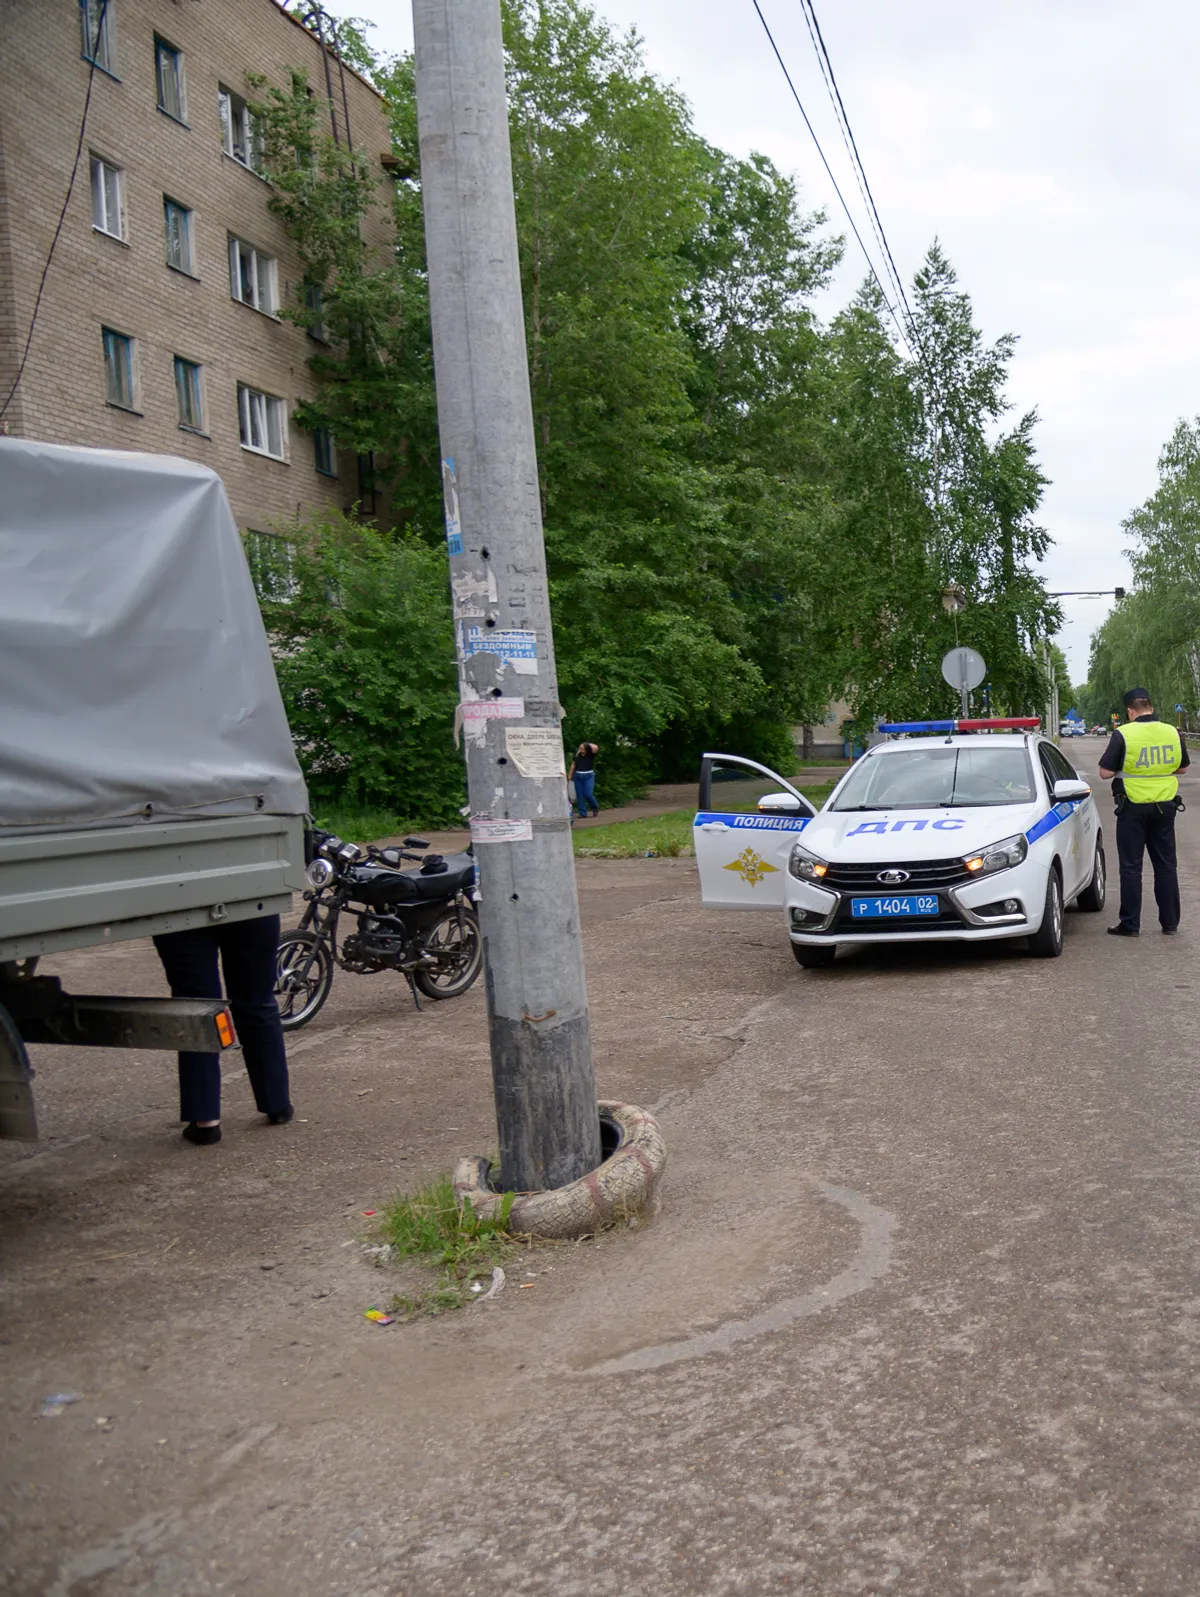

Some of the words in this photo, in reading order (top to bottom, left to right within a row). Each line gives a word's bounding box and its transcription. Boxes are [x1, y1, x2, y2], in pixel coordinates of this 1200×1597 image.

[473, 642, 532, 650] БЕЗДОМНЫМ
[1135, 745, 1175, 768] ДПС
[733, 816, 804, 830] ПОЛИЦИЯ
[846, 819, 966, 837] ДПС
[874, 899, 910, 914] 1404
[918, 897, 932, 908] 02
